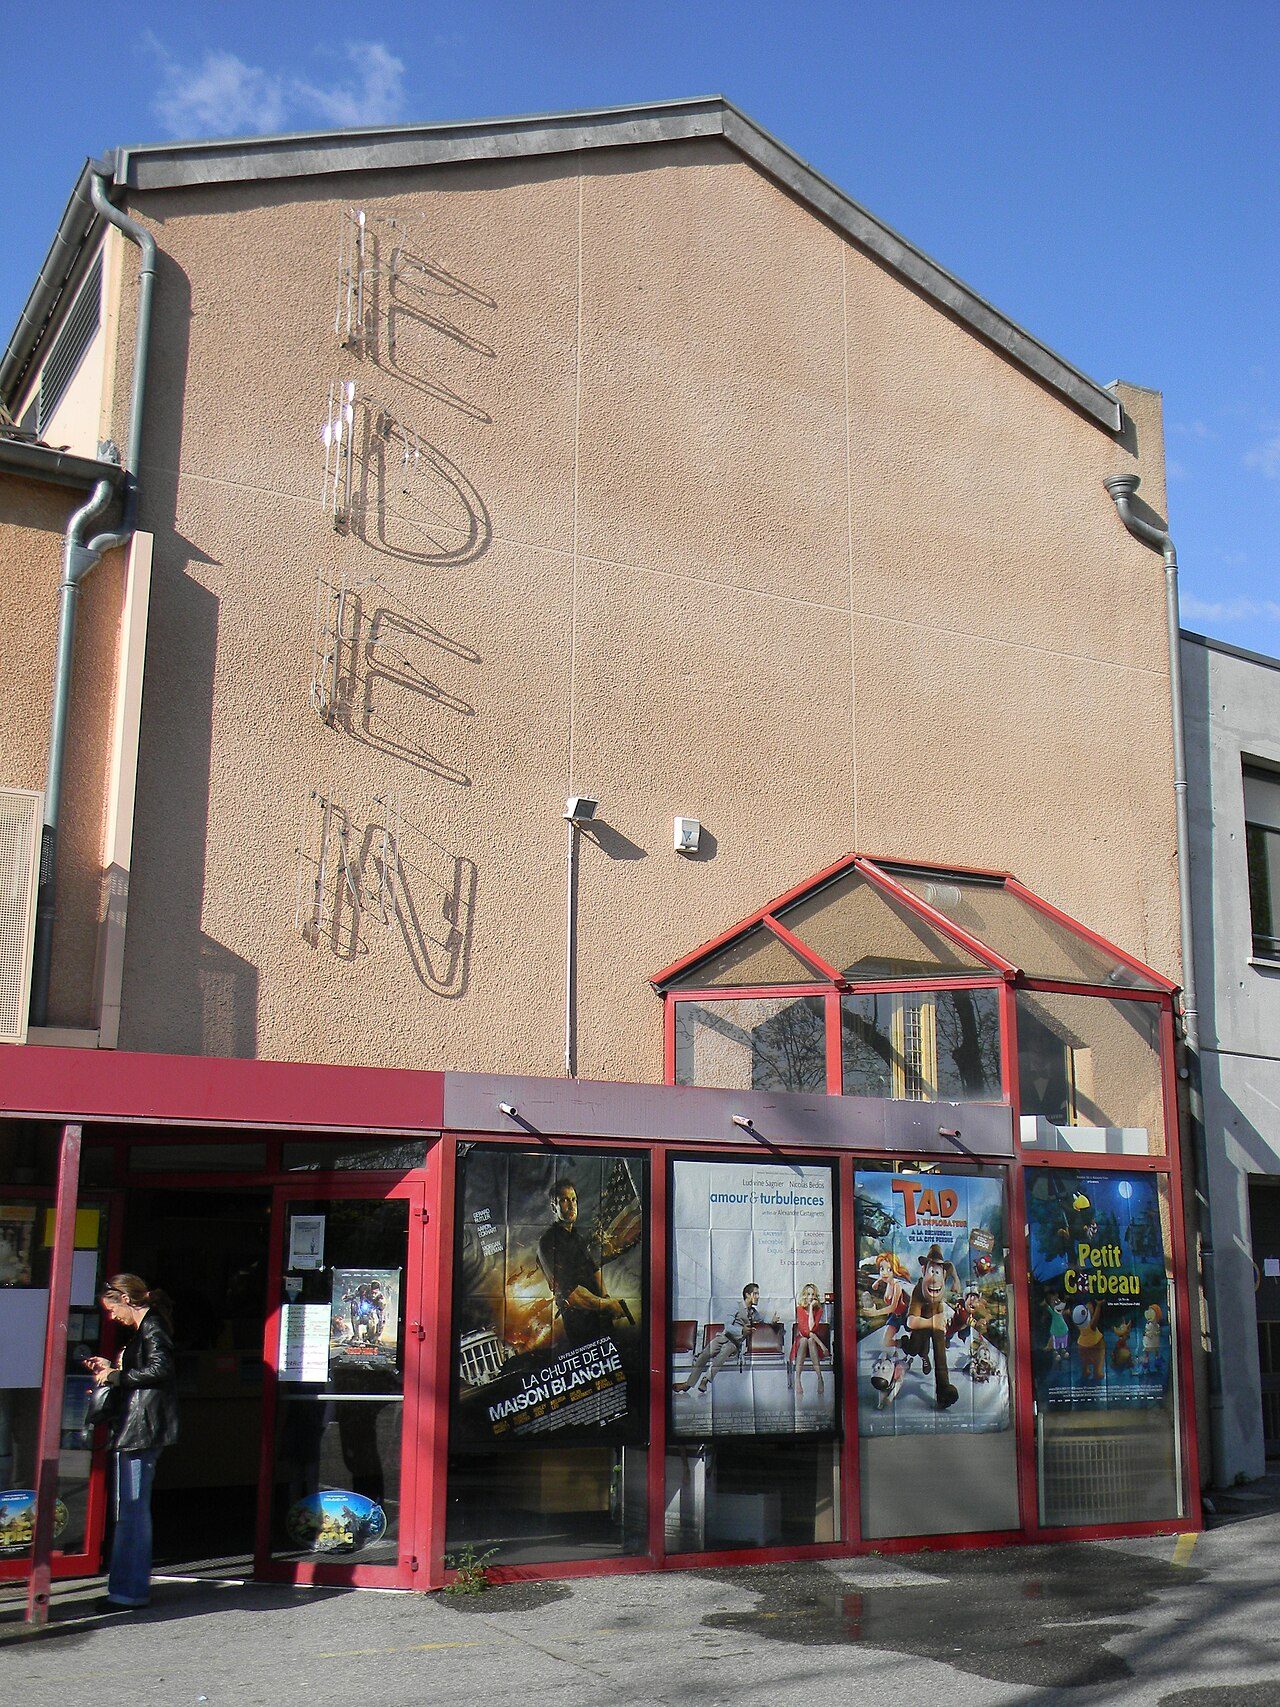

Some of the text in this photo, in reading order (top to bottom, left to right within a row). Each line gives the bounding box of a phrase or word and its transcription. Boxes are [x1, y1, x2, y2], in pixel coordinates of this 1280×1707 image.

[710, 1190, 825, 1206] amour & turbulences
[892, 1178, 958, 1228] TAD
[1078, 1243, 1121, 1268] Petit
[1064, 1269, 1141, 1295] Corbeau
[521, 1341, 618, 1390] LA CHUTE DE LA
[488, 1383, 551, 1422] MAISON
[550, 1353, 623, 1396] BLANCHE
[317, 1526, 354, 1547] epic
